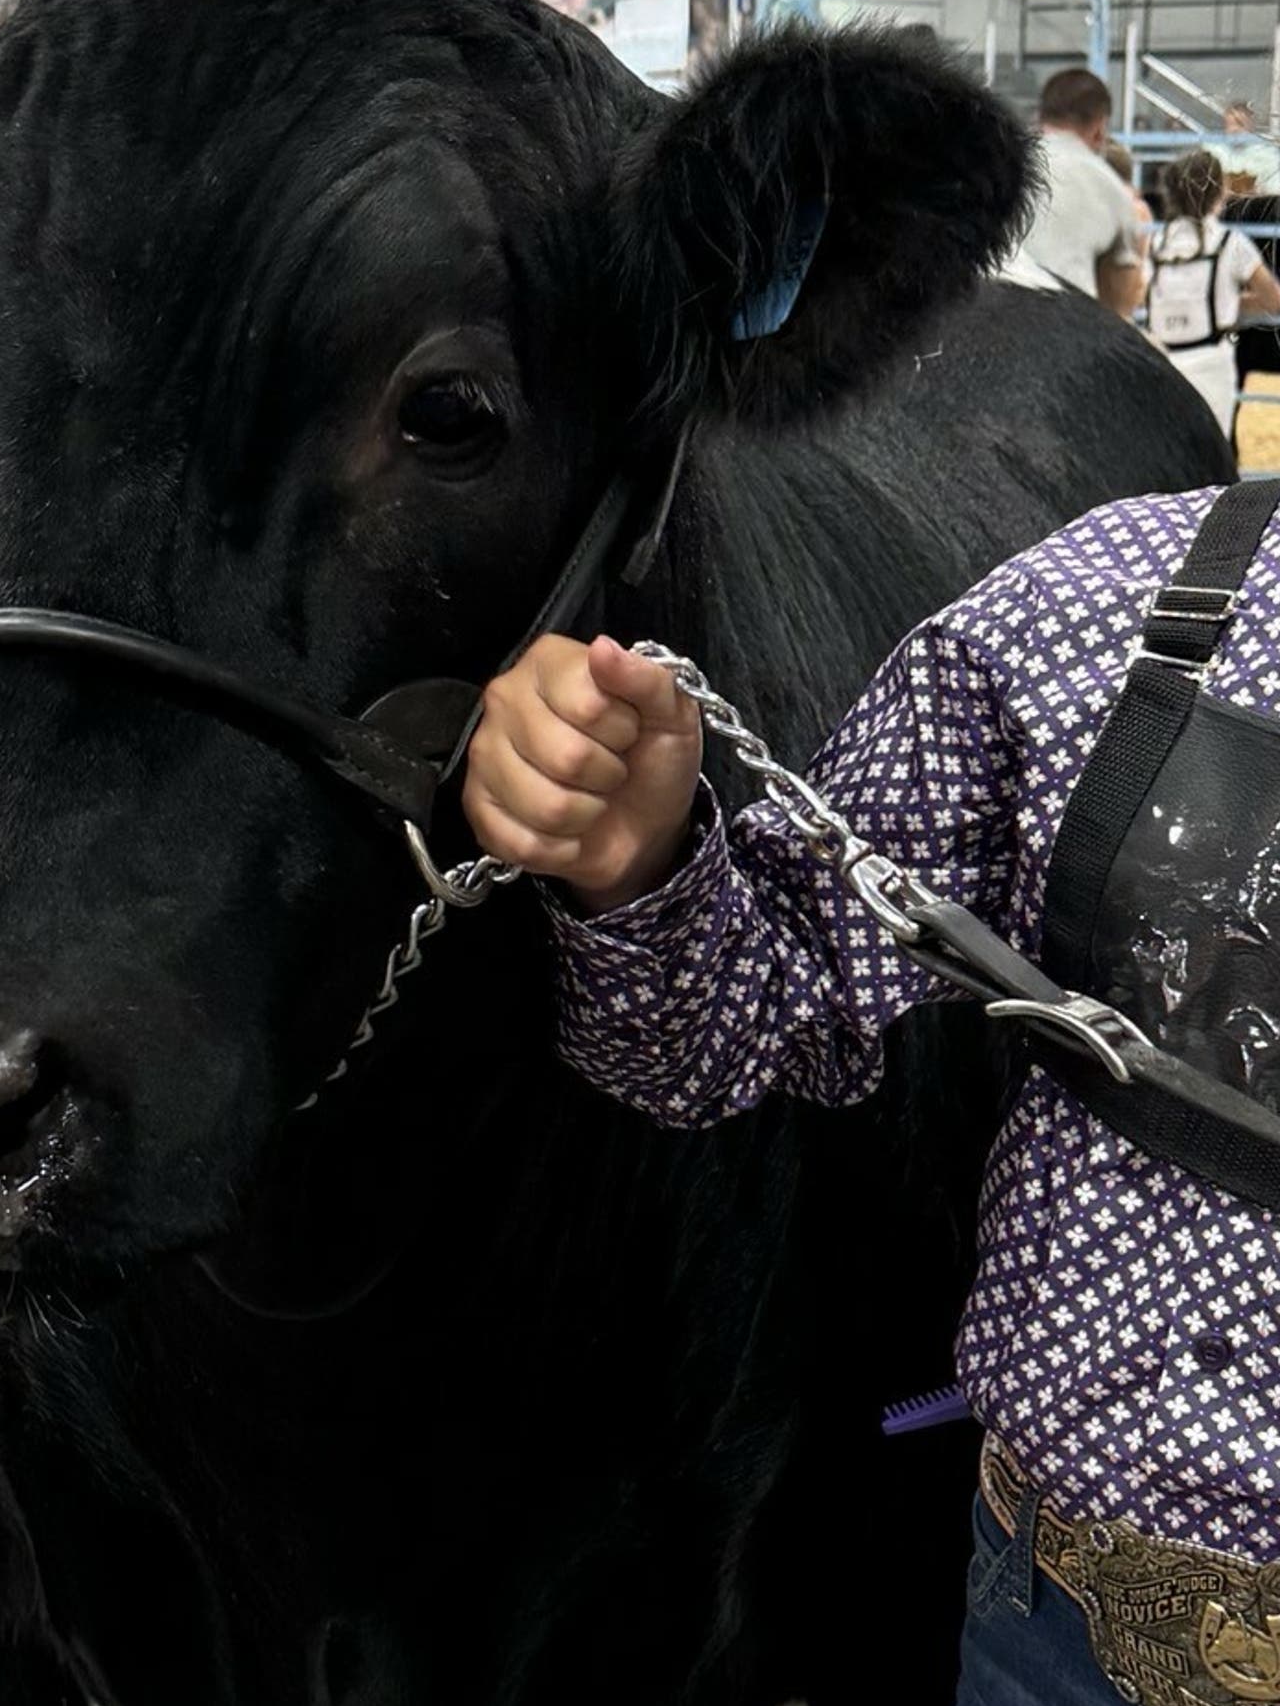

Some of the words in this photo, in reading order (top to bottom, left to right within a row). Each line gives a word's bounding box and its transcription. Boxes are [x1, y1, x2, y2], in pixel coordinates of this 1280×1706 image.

[1175, 1575, 1218, 1593] JUDGE
[1105, 1595, 1187, 1624] NOVICE
[1111, 1623, 1183, 1672] GRAND
[1119, 1651, 1173, 1699] HIGH
